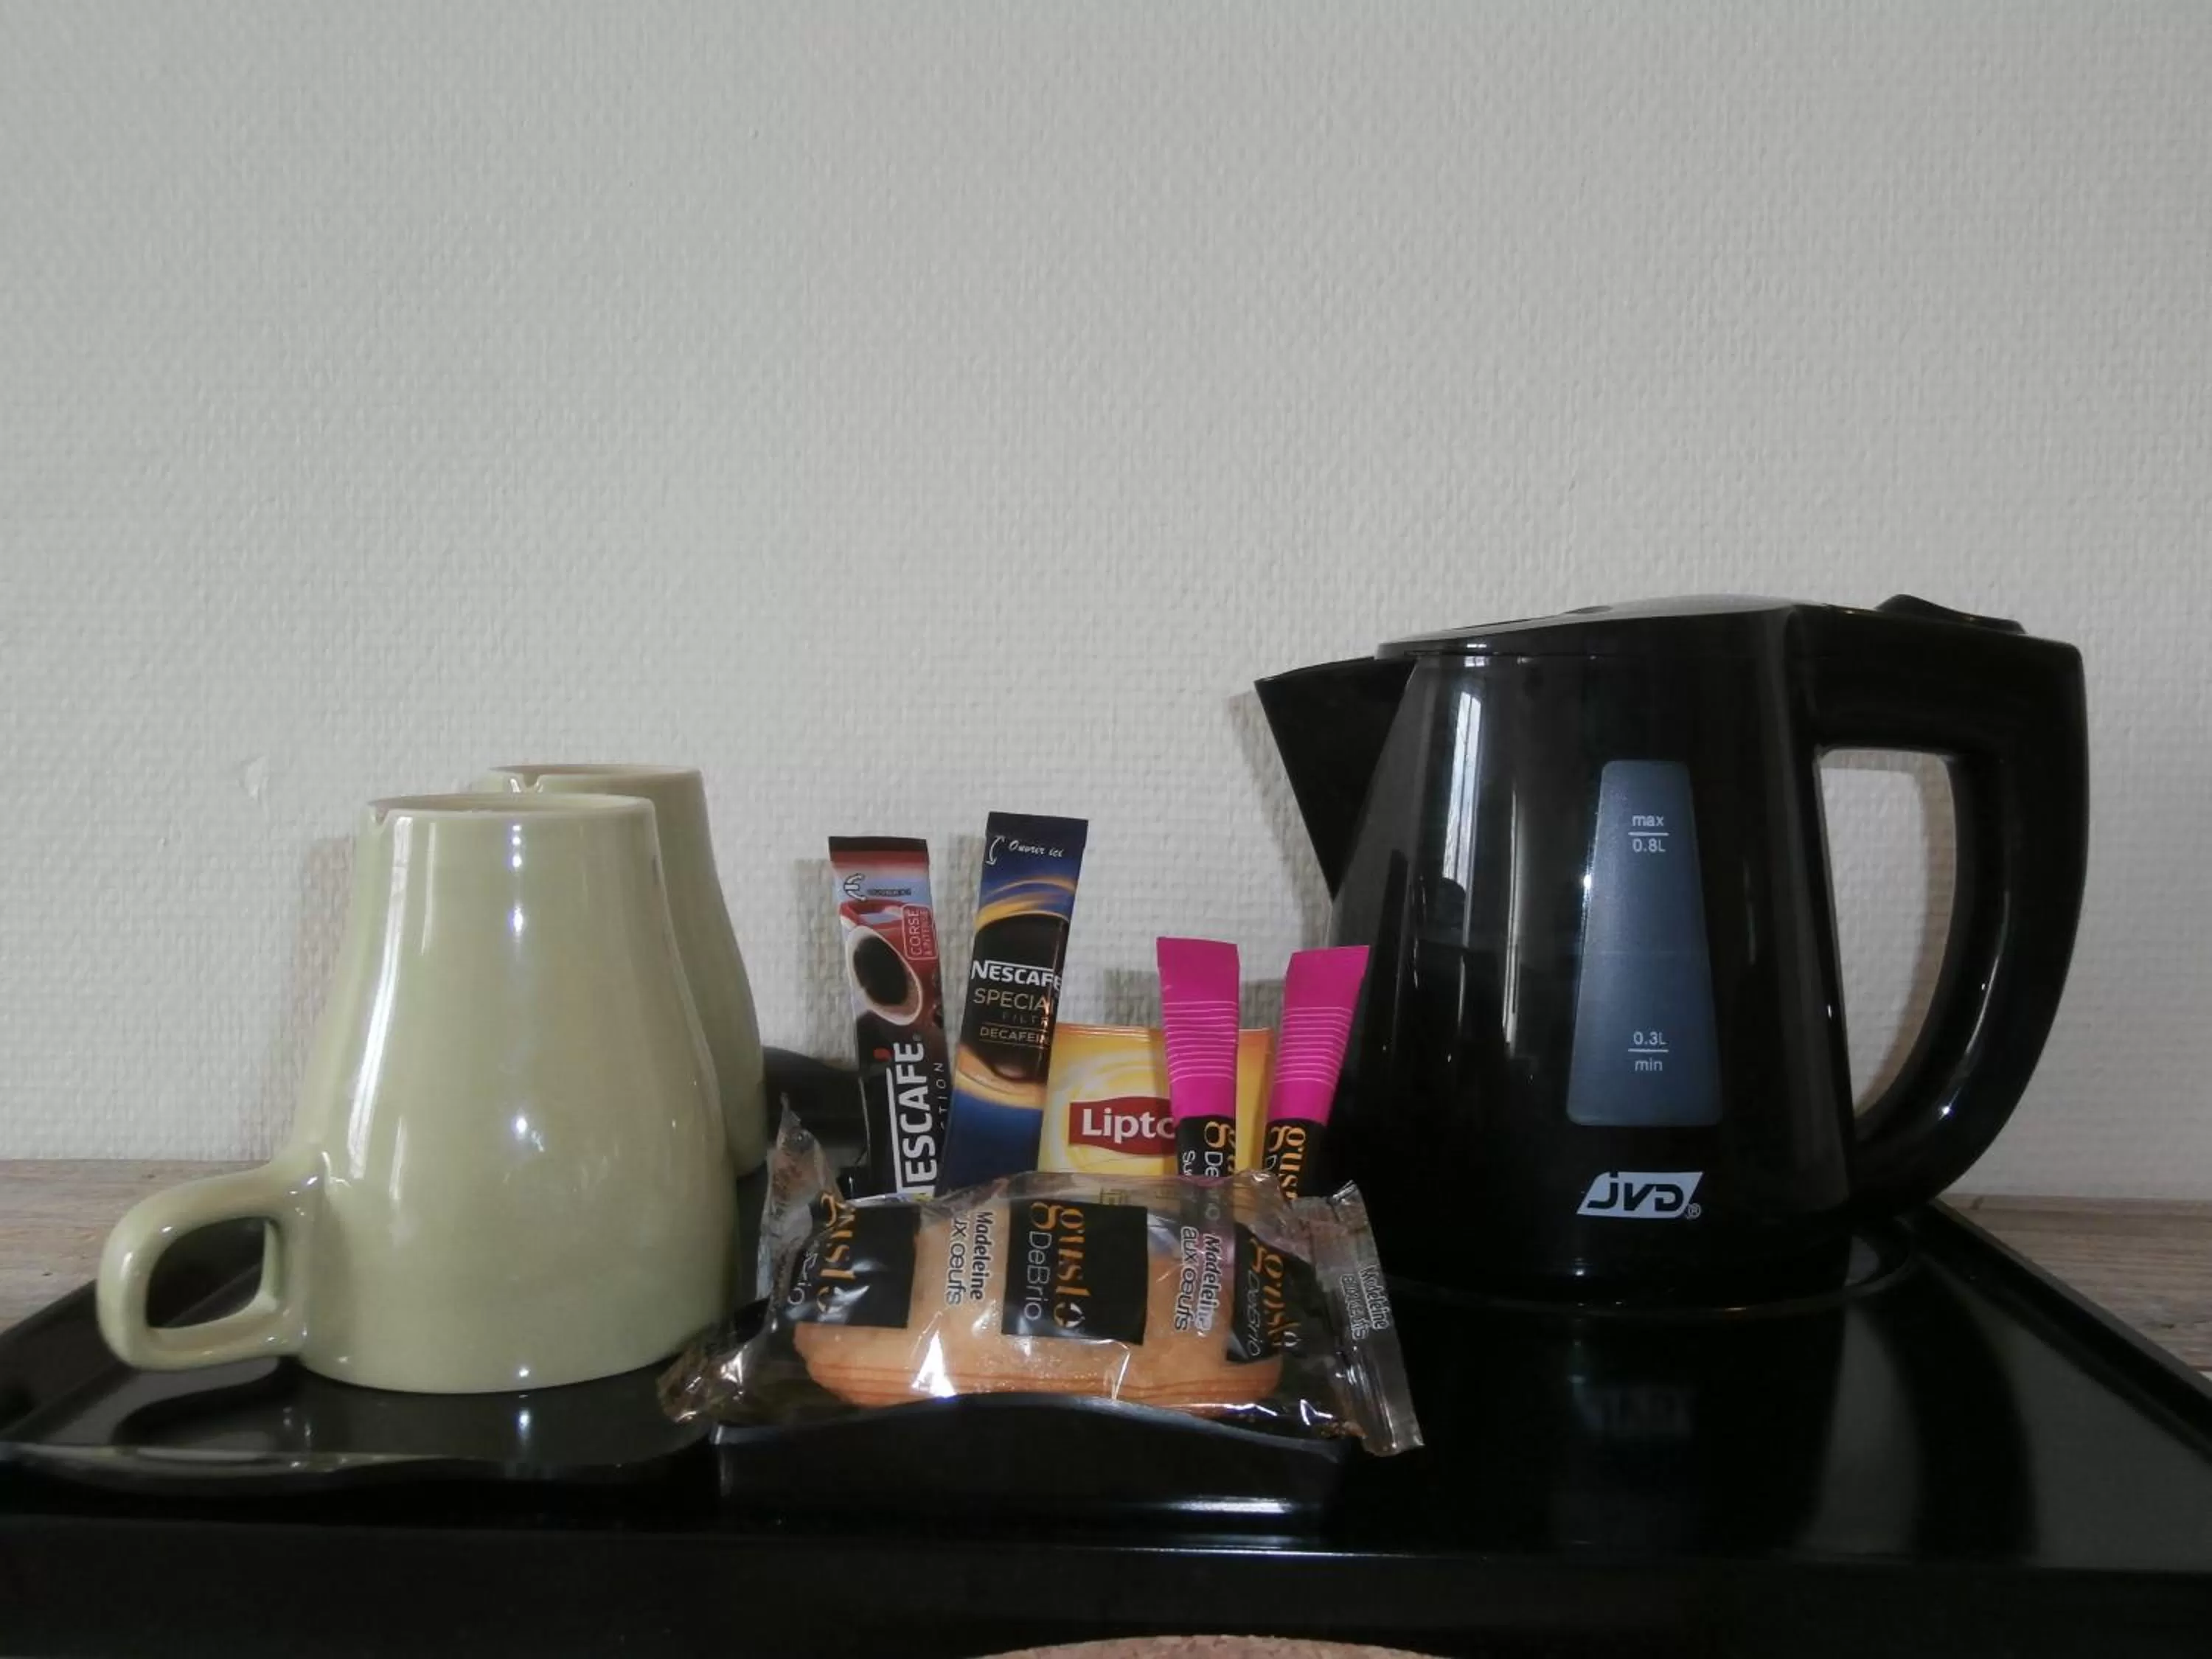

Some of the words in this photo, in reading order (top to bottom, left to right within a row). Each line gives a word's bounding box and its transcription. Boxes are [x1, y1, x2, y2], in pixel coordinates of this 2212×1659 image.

[1632, 815, 1664, 827] max
[1632, 837, 1666, 853] 0.8L
[1633, 1031, 1666, 1046] 0.3L
[1635, 1057, 1663, 1071] min
[1082, 1107, 1175, 1144] Lipto
[970, 1211, 994, 1301] Madeleine
[1023, 1231, 1052, 1321] DeBrio
